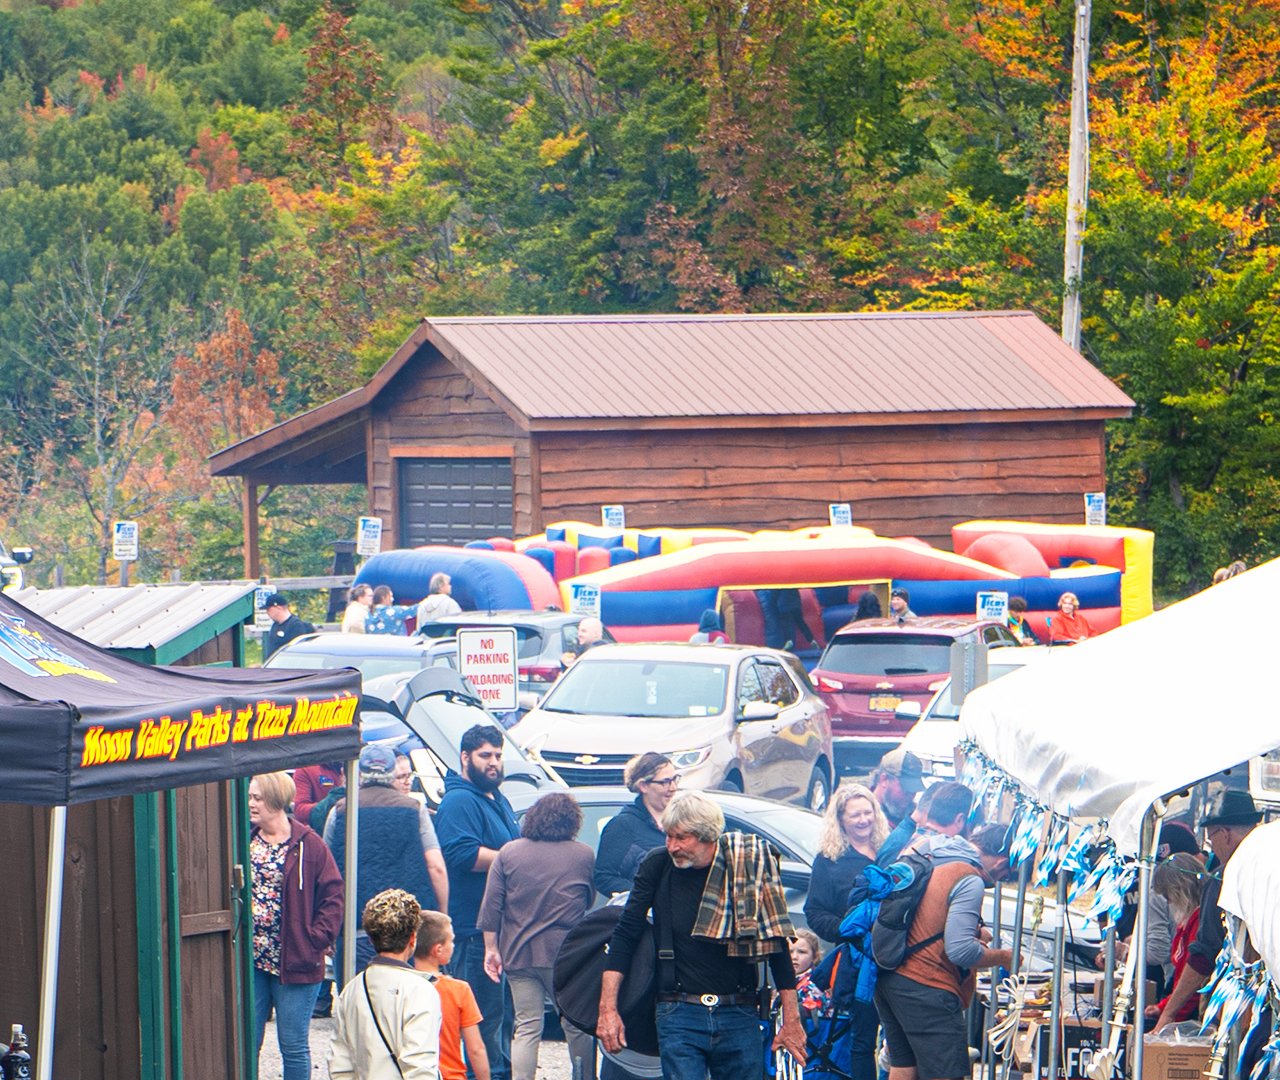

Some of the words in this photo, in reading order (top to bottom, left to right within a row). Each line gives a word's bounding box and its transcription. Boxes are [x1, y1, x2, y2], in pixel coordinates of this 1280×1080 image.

[480, 638, 495, 650] NO
[466, 652, 510, 665] PARKING
[81, 725, 134, 768] Moon
[135, 715, 188, 762] Valley
[184, 705, 233, 752] Parks
[231, 704, 253, 743] at
[252, 699, 293, 741] Titus
[287, 690, 359, 735] Mountain
